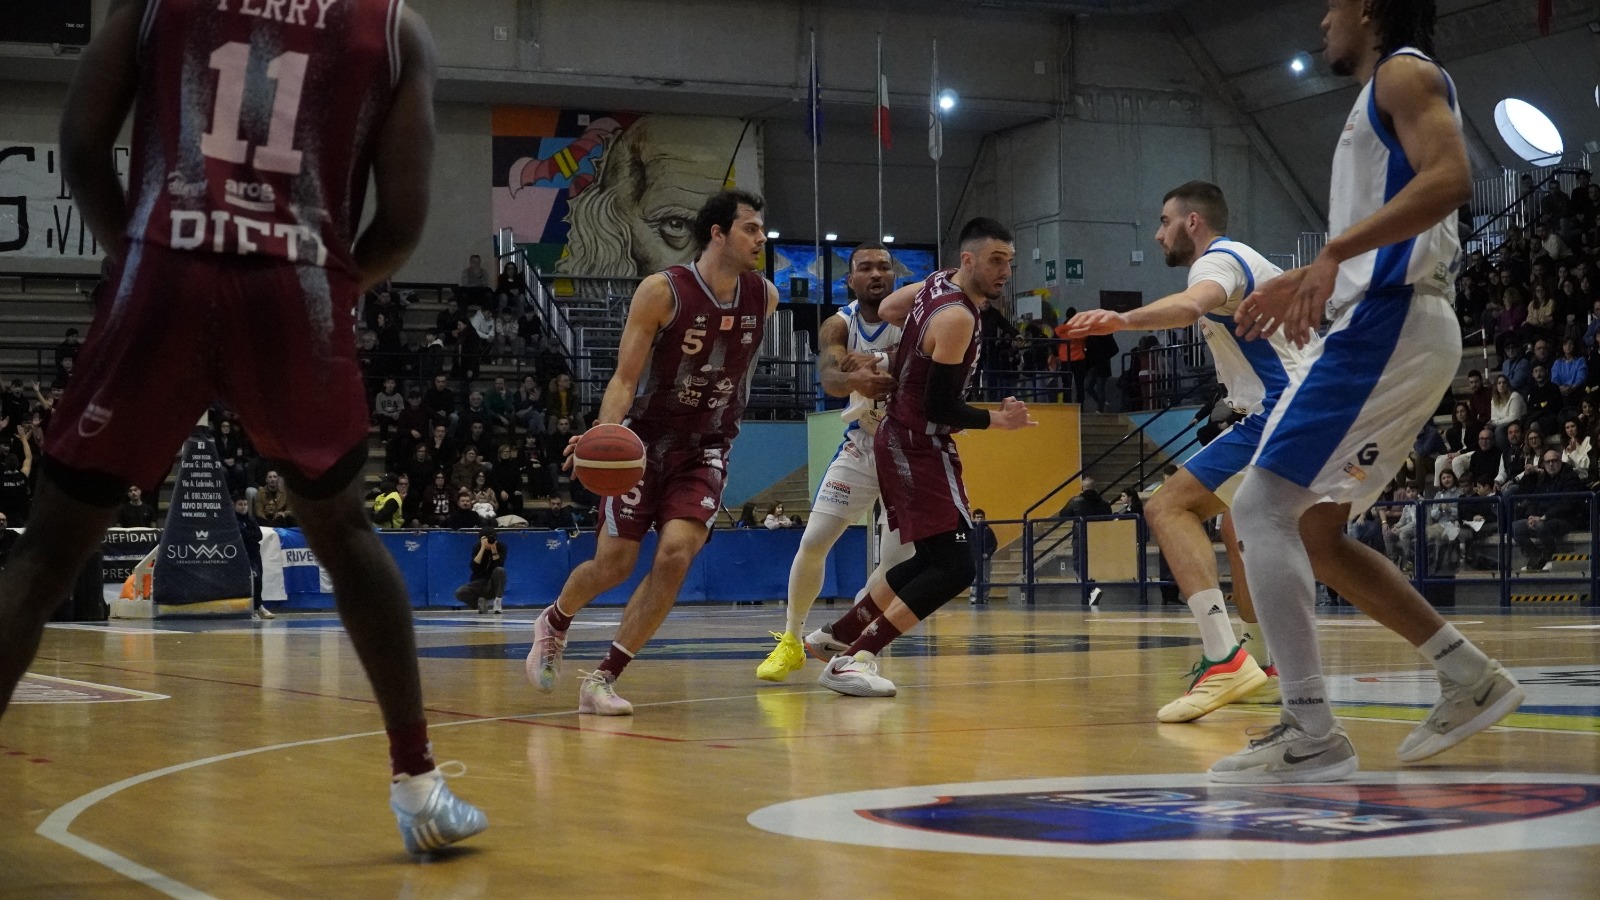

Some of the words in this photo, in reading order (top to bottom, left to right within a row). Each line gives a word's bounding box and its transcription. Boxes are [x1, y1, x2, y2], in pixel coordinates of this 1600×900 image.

[201, 40, 310, 175] 11
[681, 329, 707, 357] 5
[381, 400, 399, 409] USA
[195, 460, 201, 469] G.
[182, 479, 190, 487] Via
[215, 479, 222, 488] 11
[182, 502, 196, 510] RUVO
[196, 502, 203, 510] DI
[203, 502, 222, 510] PUGLIA
[1434, 638, 1464, 660] adidas
[1287, 697, 1323, 706] adidas
